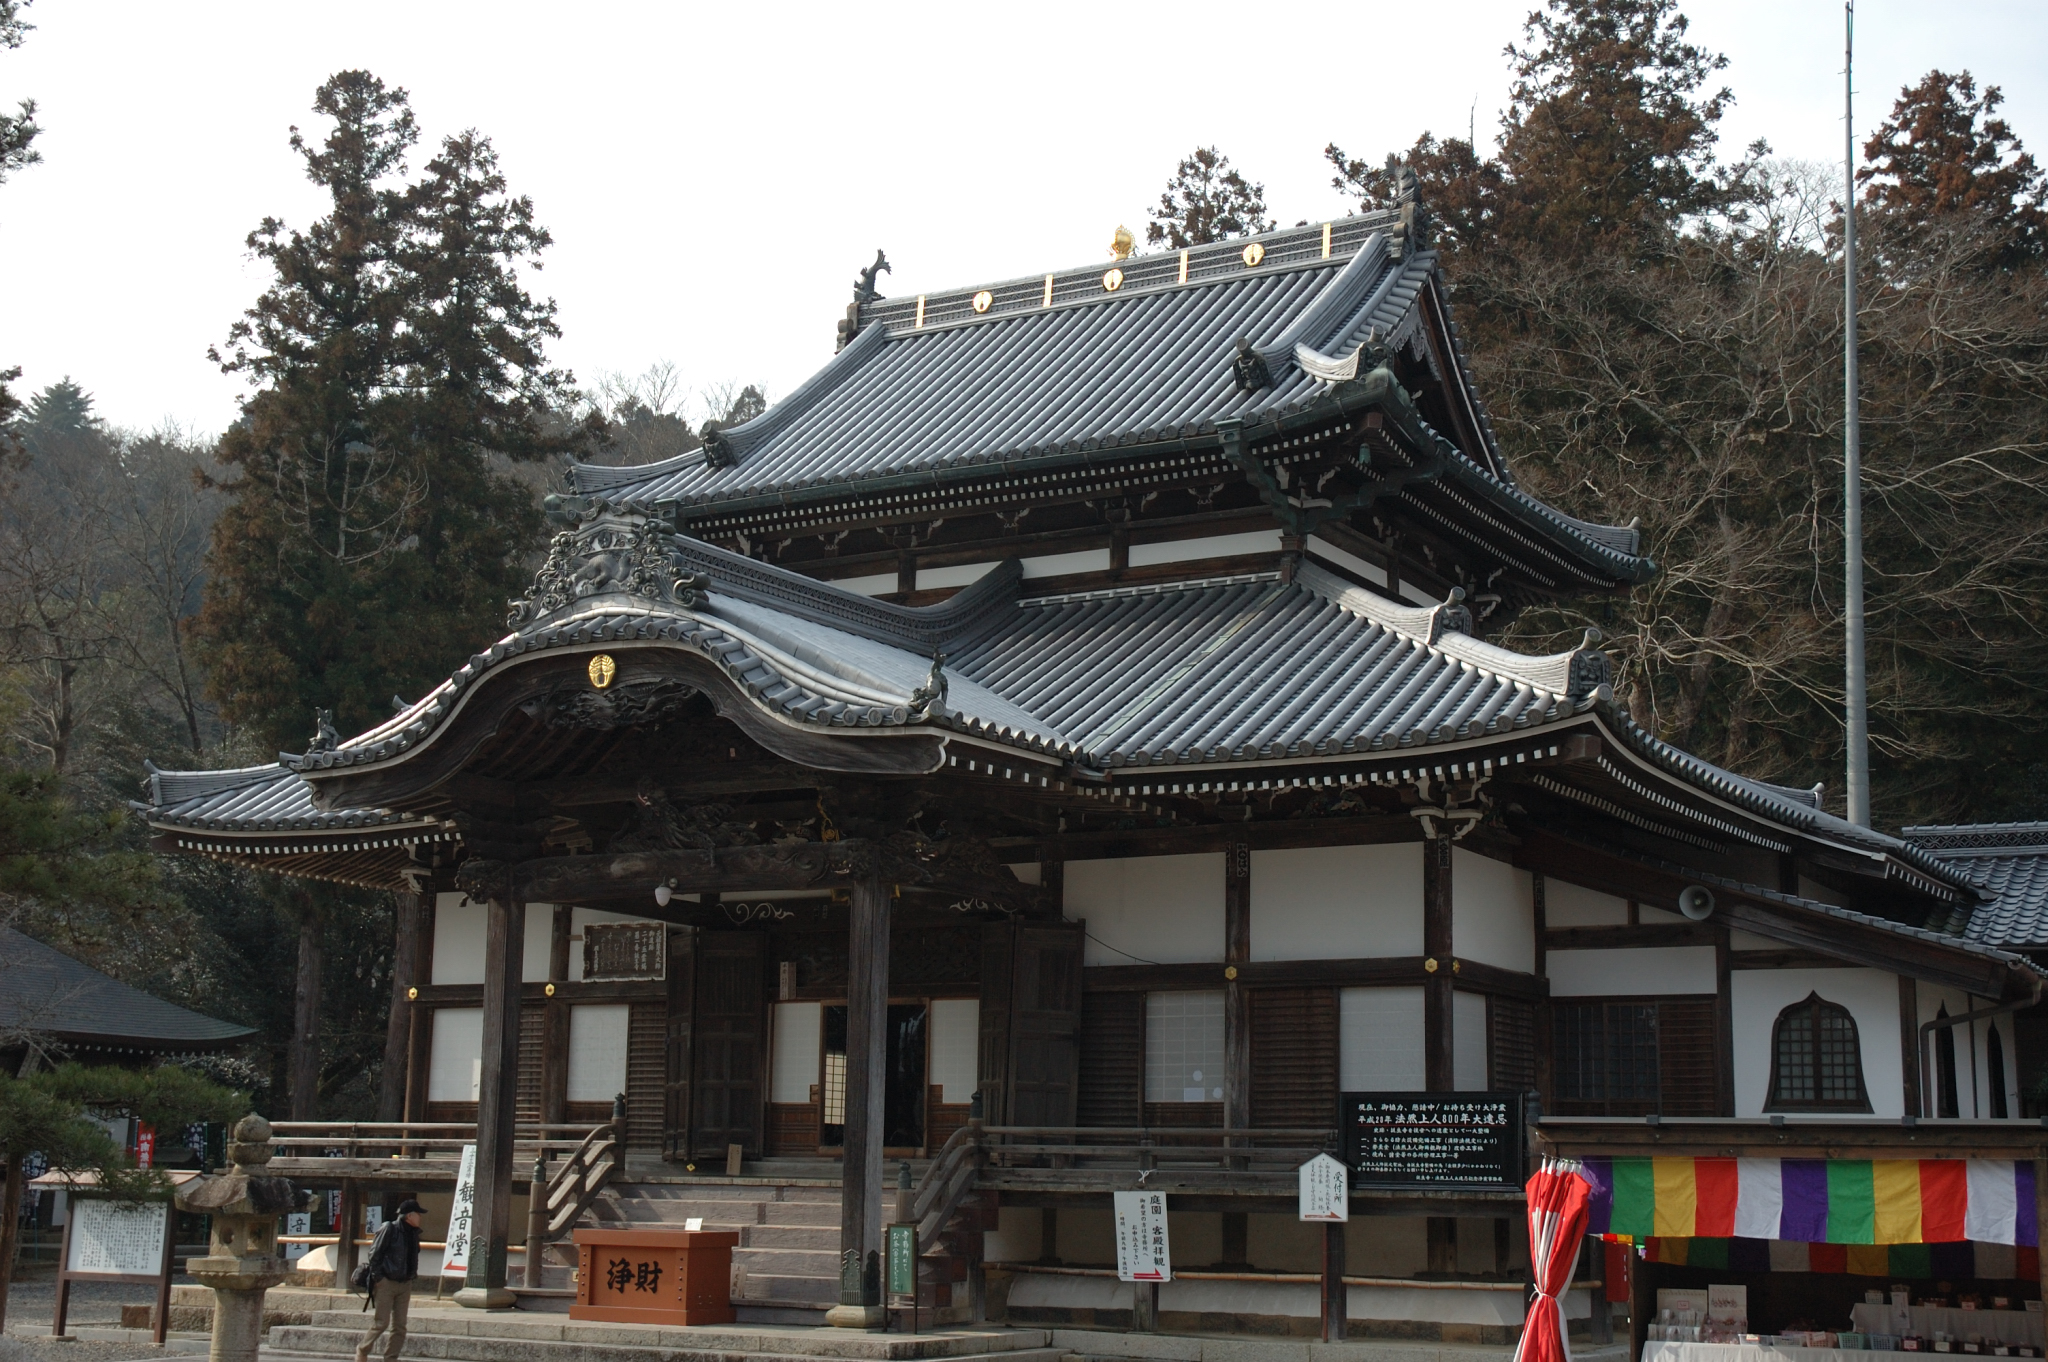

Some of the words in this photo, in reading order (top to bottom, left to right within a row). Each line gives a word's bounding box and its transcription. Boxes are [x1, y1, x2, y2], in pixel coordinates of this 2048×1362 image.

[1333, 1171, 1343, 1205] 受付所
[452, 1180, 475, 1257] 観音堂
[1150, 1195, 1166, 1267] 庭園・客殿拝観
[1132, 1224, 1140, 1265] お申込み下さい
[607, 1258, 664, 1294] 浄財
